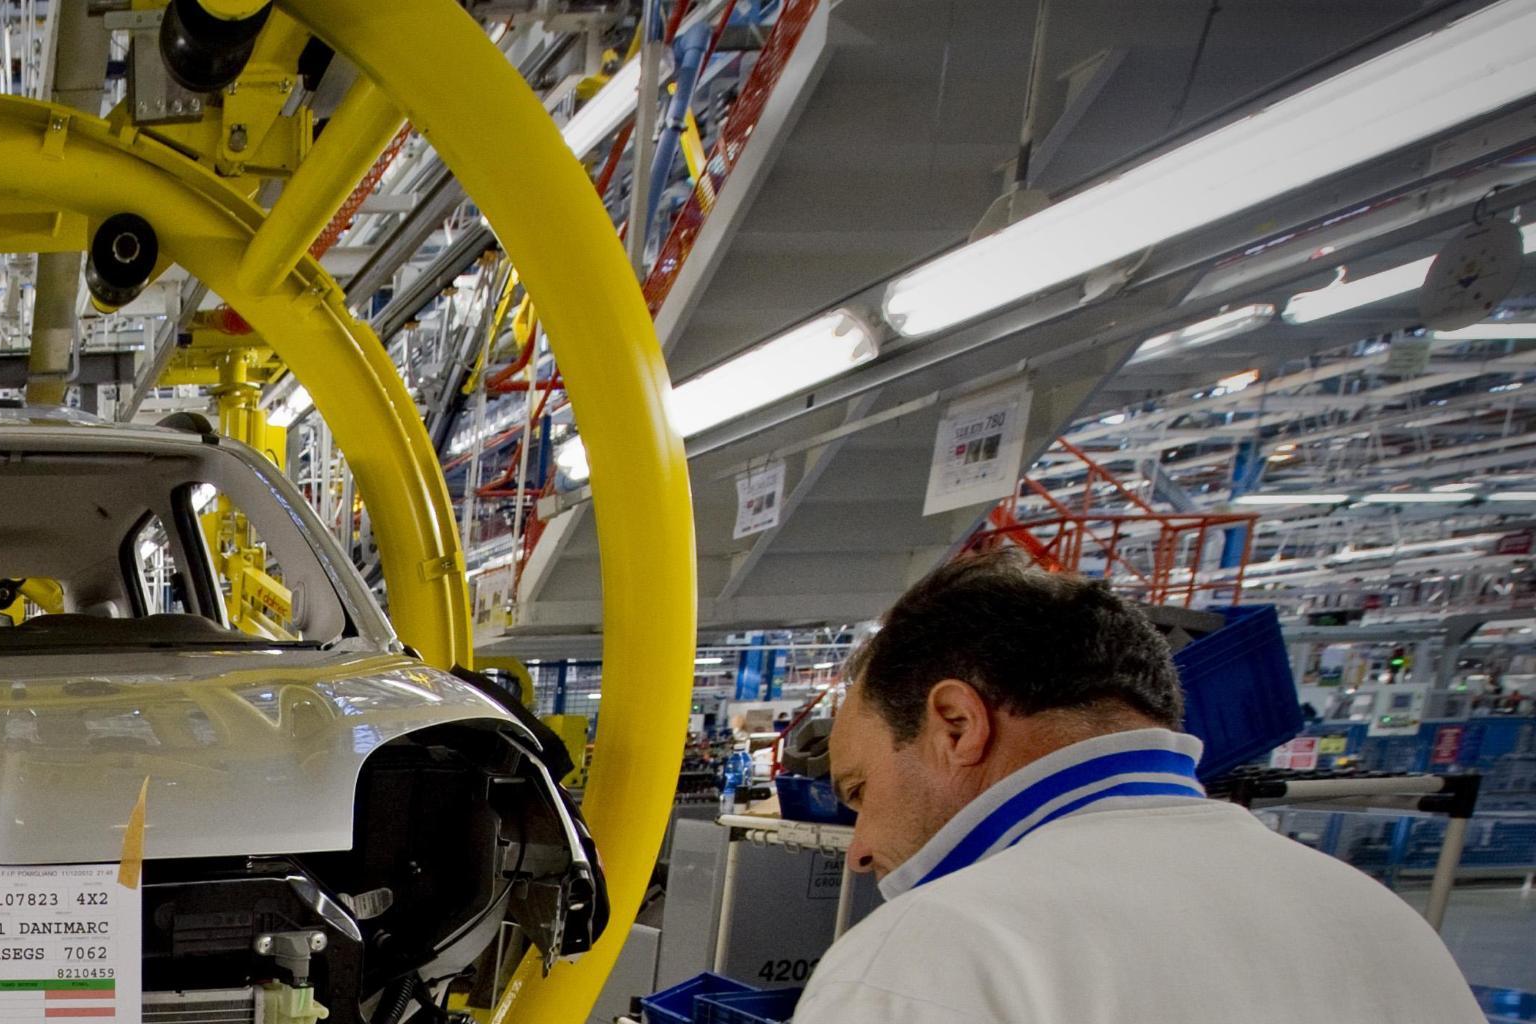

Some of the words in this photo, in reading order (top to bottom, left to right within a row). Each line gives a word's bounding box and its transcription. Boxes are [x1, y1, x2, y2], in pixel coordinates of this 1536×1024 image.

[815, 879, 842, 888] GROU
[76, 892, 108, 905] 4X2
[19, 921, 109, 934] DANIMARC
[64, 946, 107, 960] 7062
[57, 968, 115, 979] 8210459
